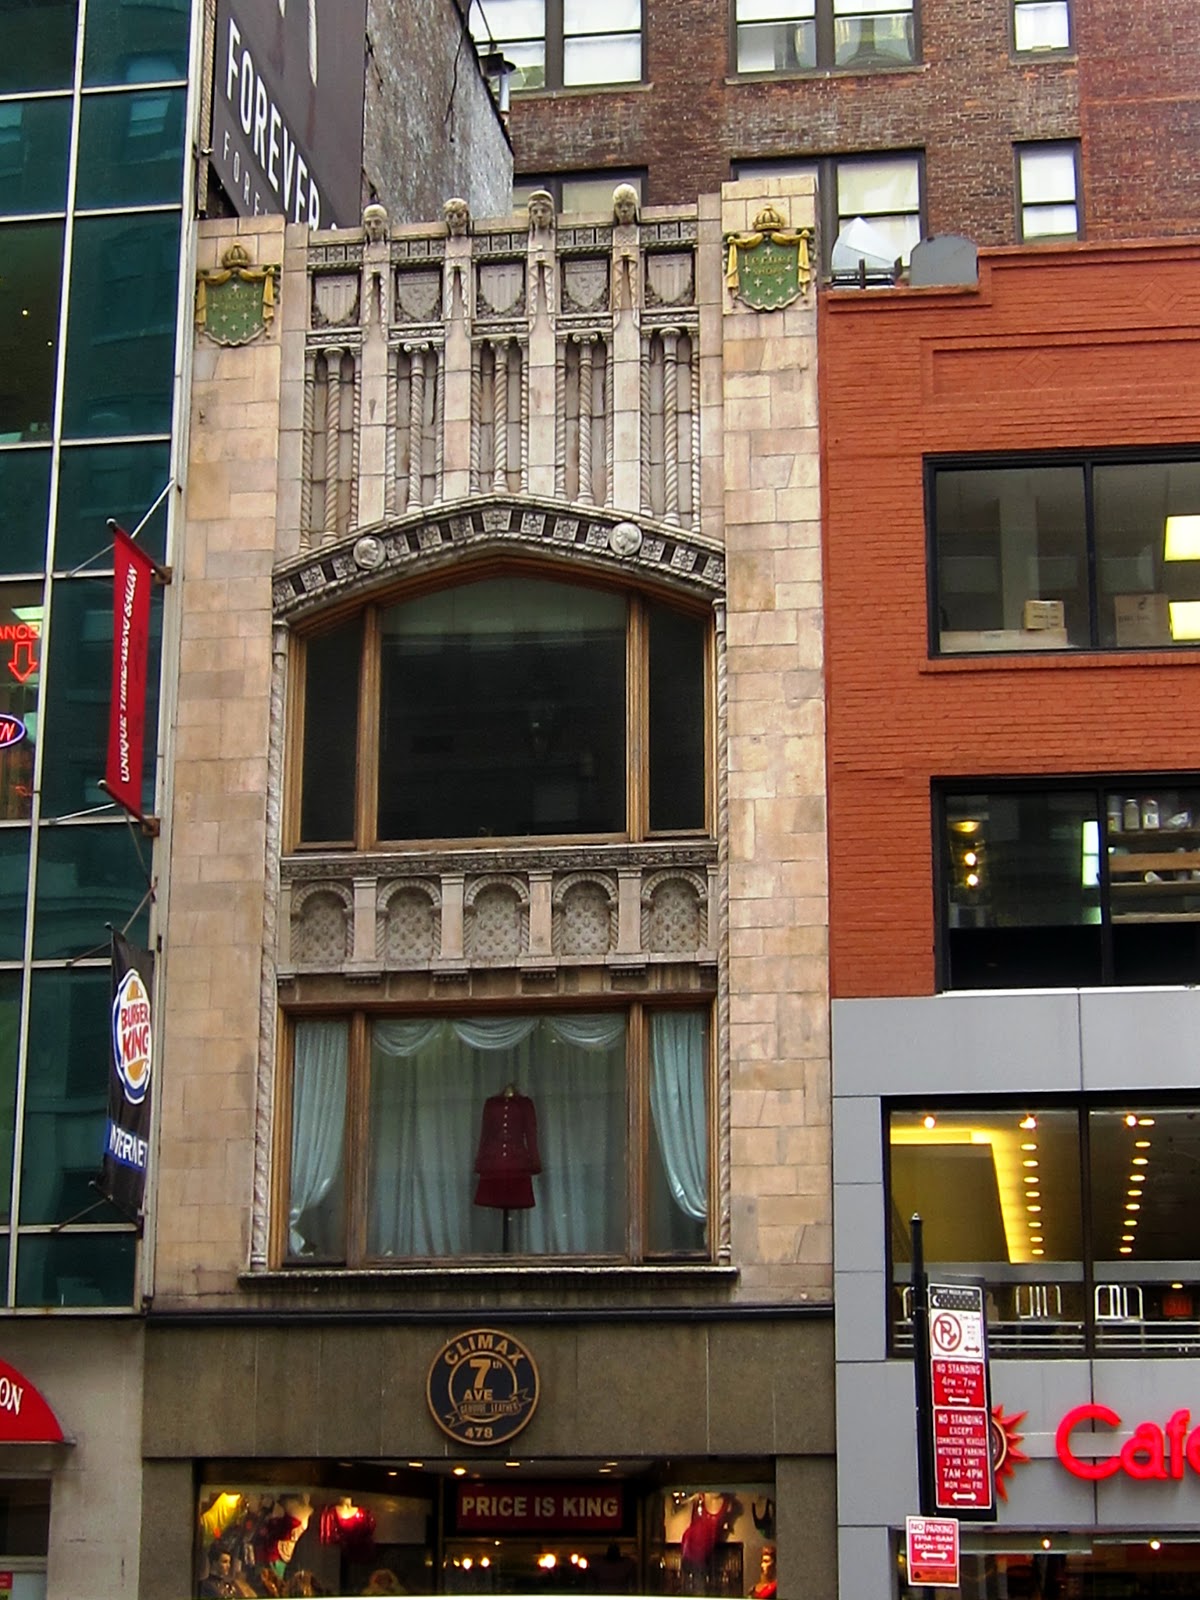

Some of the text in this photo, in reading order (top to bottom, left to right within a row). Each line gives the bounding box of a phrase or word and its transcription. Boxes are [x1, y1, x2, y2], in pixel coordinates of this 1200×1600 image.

[223, 130, 269, 217] FORE
[120, 714, 130, 783] UNIQUE
[121, 1003, 149, 1031] BURGER
[122, 1025, 149, 1062] KING
[444, 1334, 525, 1367] CLIMAX
[948, 1363, 980, 1375] STANDING
[463, 1389, 493, 1401] AVE
[938, 1413, 983, 1425] NO STANDING
[465, 1426, 493, 1439] 478
[949, 1426, 973, 1435] EXCEPT
[963, 1447, 986, 1456] PARKING
[962, 1458, 980, 1466] LIMIT
[461, 1497, 619, 1517] PRICE IS KING
[910, 1522, 954, 1535] NO PARKING
